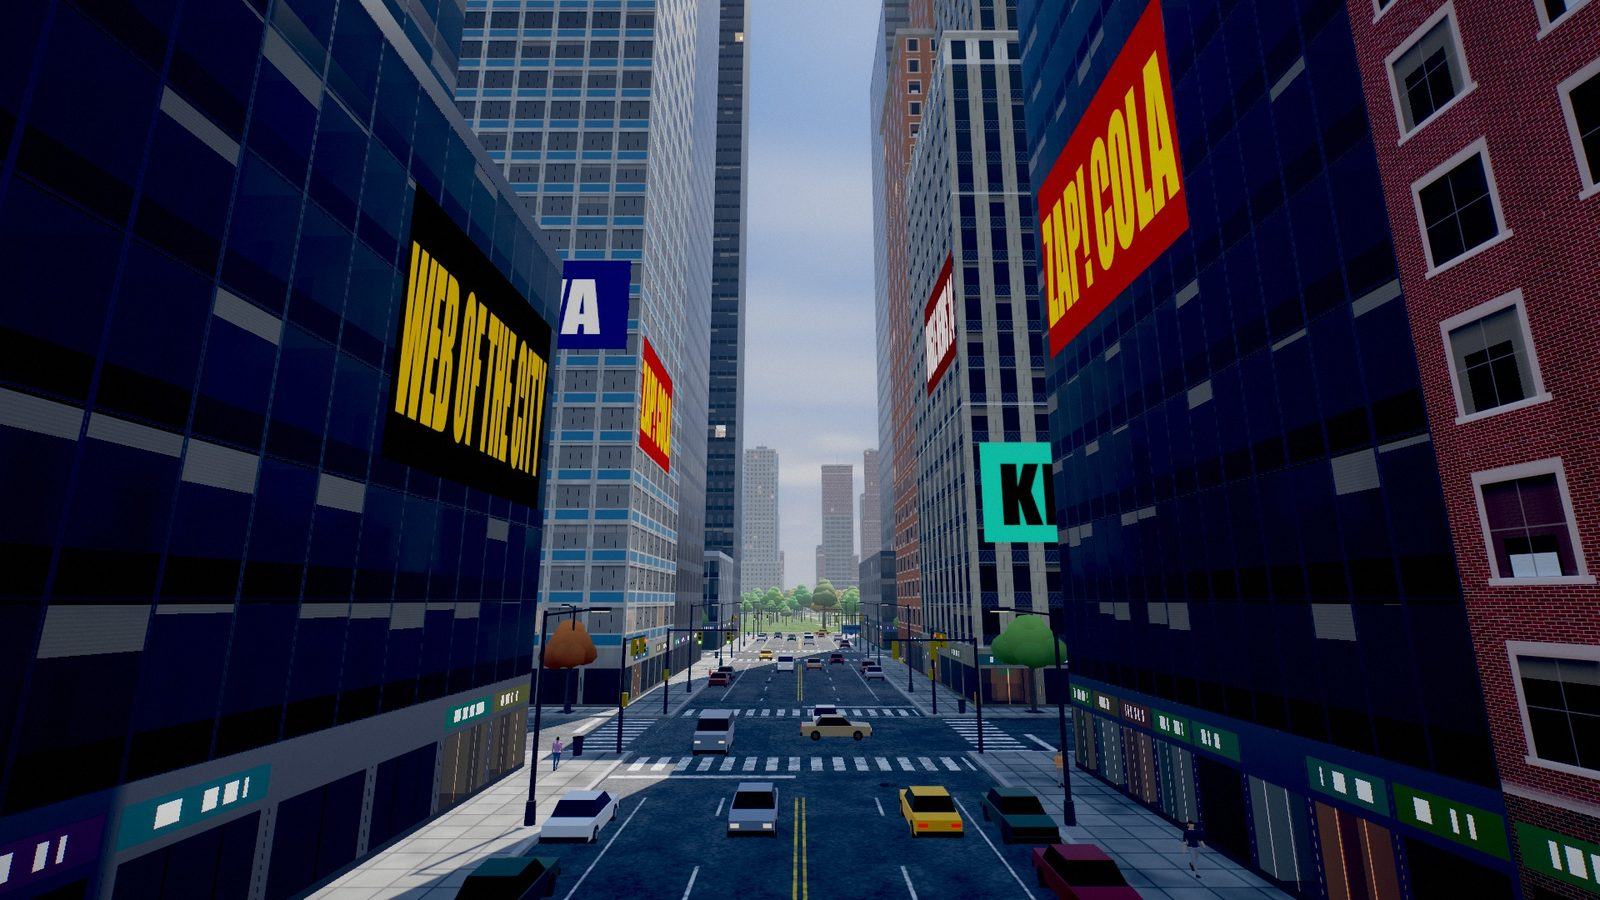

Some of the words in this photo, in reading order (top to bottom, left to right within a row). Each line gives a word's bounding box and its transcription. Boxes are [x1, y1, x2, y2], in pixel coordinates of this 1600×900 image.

[560, 278, 601, 335] A
[1042, 165, 1095, 329] ZAP!
[1090, 50, 1181, 271] COLA
[394, 241, 461, 433] WEB
[453, 292, 488, 446] OF
[480, 312, 517, 463] THE
[511, 340, 548, 477] CITY
